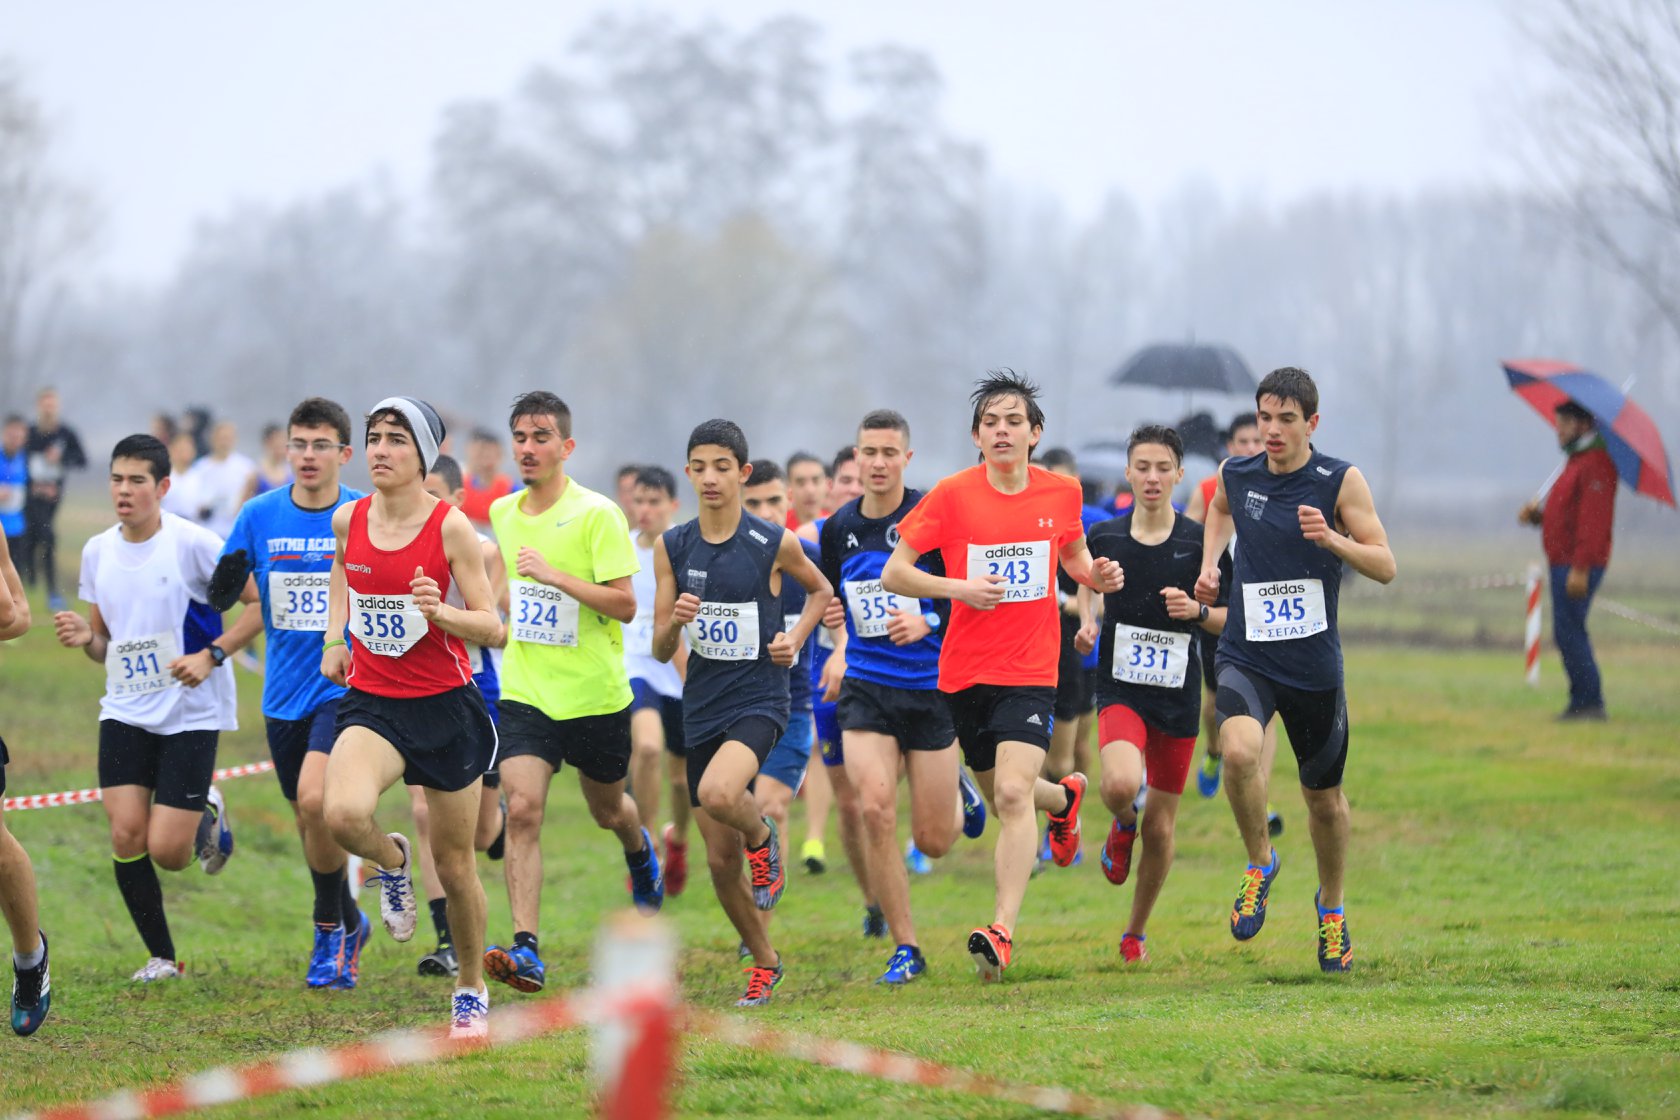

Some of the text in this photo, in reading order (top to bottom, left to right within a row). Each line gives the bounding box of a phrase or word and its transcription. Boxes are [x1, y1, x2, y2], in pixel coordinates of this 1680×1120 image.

[985, 545, 1033, 559] adidas
[988, 560, 1030, 585] 343
[283, 575, 330, 587] adidas
[519, 586, 562, 602] adidas
[856, 582, 882, 595] adid
[1005, 588, 1030, 599] ΓΑΣ
[1258, 583, 1305, 597] adidas
[287, 591, 327, 614] 385
[357, 597, 405, 610] adidas
[860, 595, 899, 620] 355
[517, 599, 559, 628] 324
[1263, 597, 1306, 624] 345
[288, 618, 328, 629] ΣΕΓΑΣ
[360, 612, 406, 639] 358
[866, 623, 887, 634] ΣΕΓ
[517, 628, 557, 642] ΣΕΓΑΣ
[696, 618, 738, 644] 360
[1130, 631, 1175, 645] adidas
[1267, 625, 1307, 638] ΣΕΓΑΣ
[116, 639, 158, 654] adidas
[367, 641, 406, 654] ΣΕΓΑΣ
[700, 646, 738, 657] ΣΕΓΑΣ
[1129, 644, 1169, 670] 331
[121, 652, 160, 679] 341
[1129, 670, 1167, 684] ΣΕΓΑΣ
[128, 679, 166, 693] ΣΕΓΑΣ
